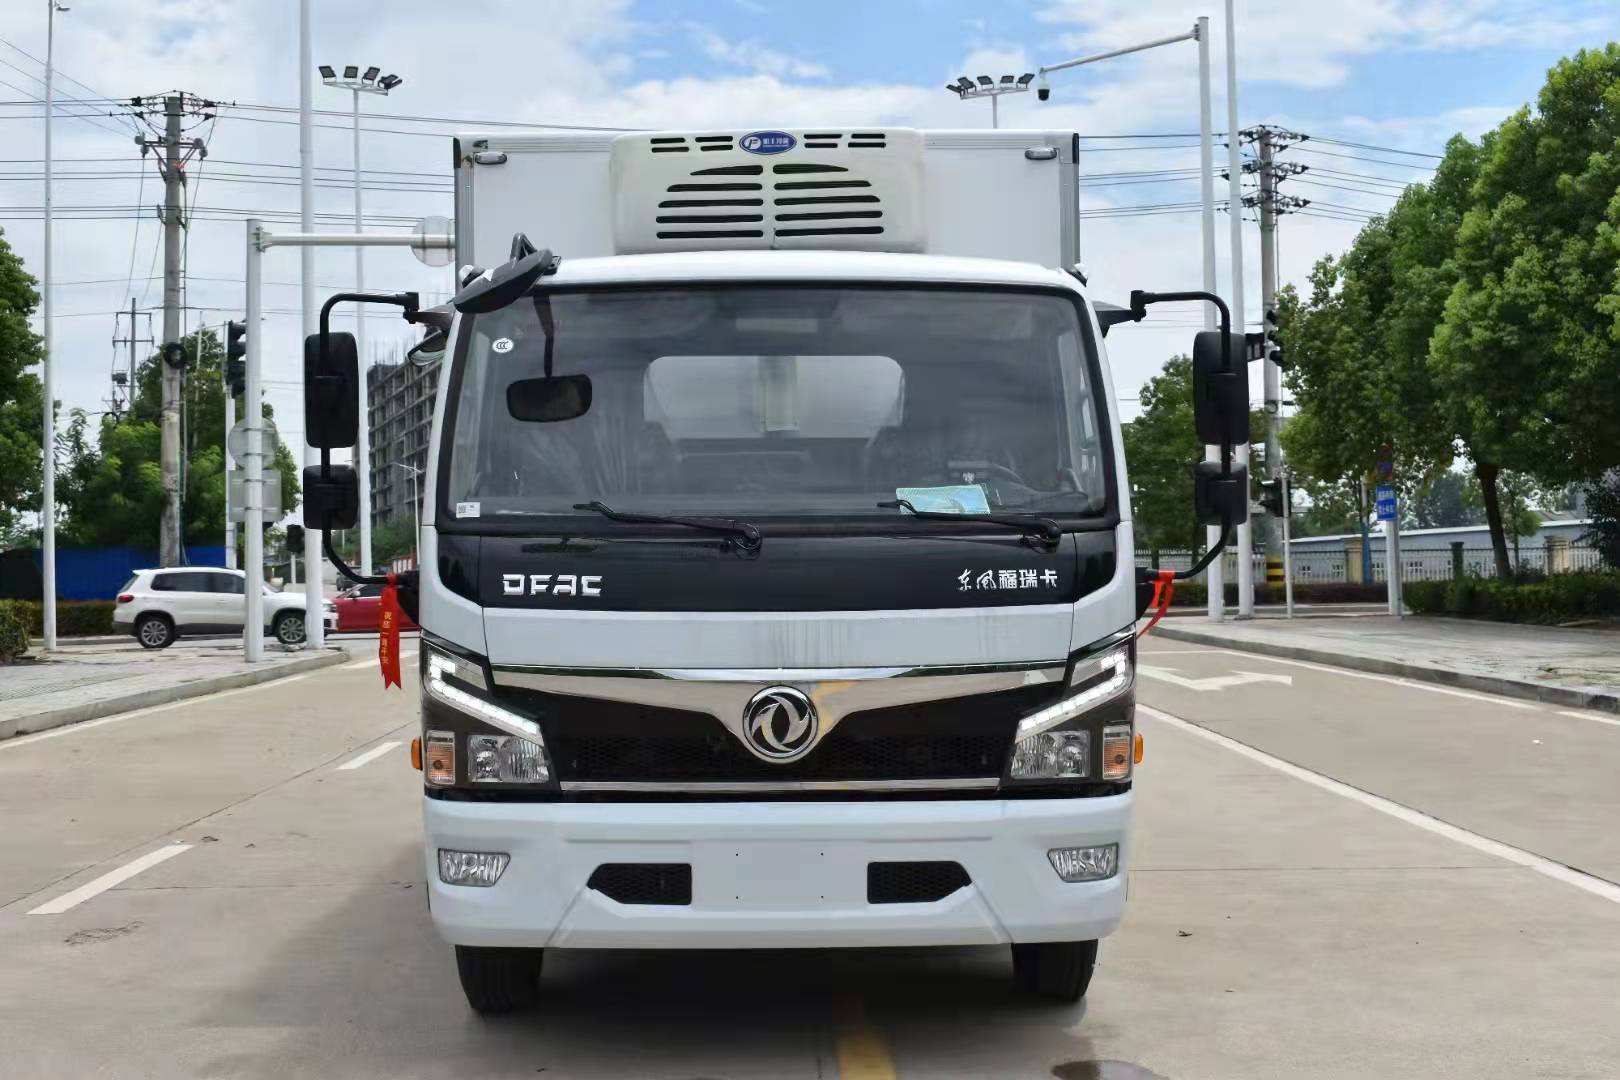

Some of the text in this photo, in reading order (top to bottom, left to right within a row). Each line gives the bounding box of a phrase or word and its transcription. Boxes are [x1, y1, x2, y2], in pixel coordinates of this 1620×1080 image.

[502, 573, 602, 597] DFAC
[958, 568, 1058, 591] 东风福瑞卡
